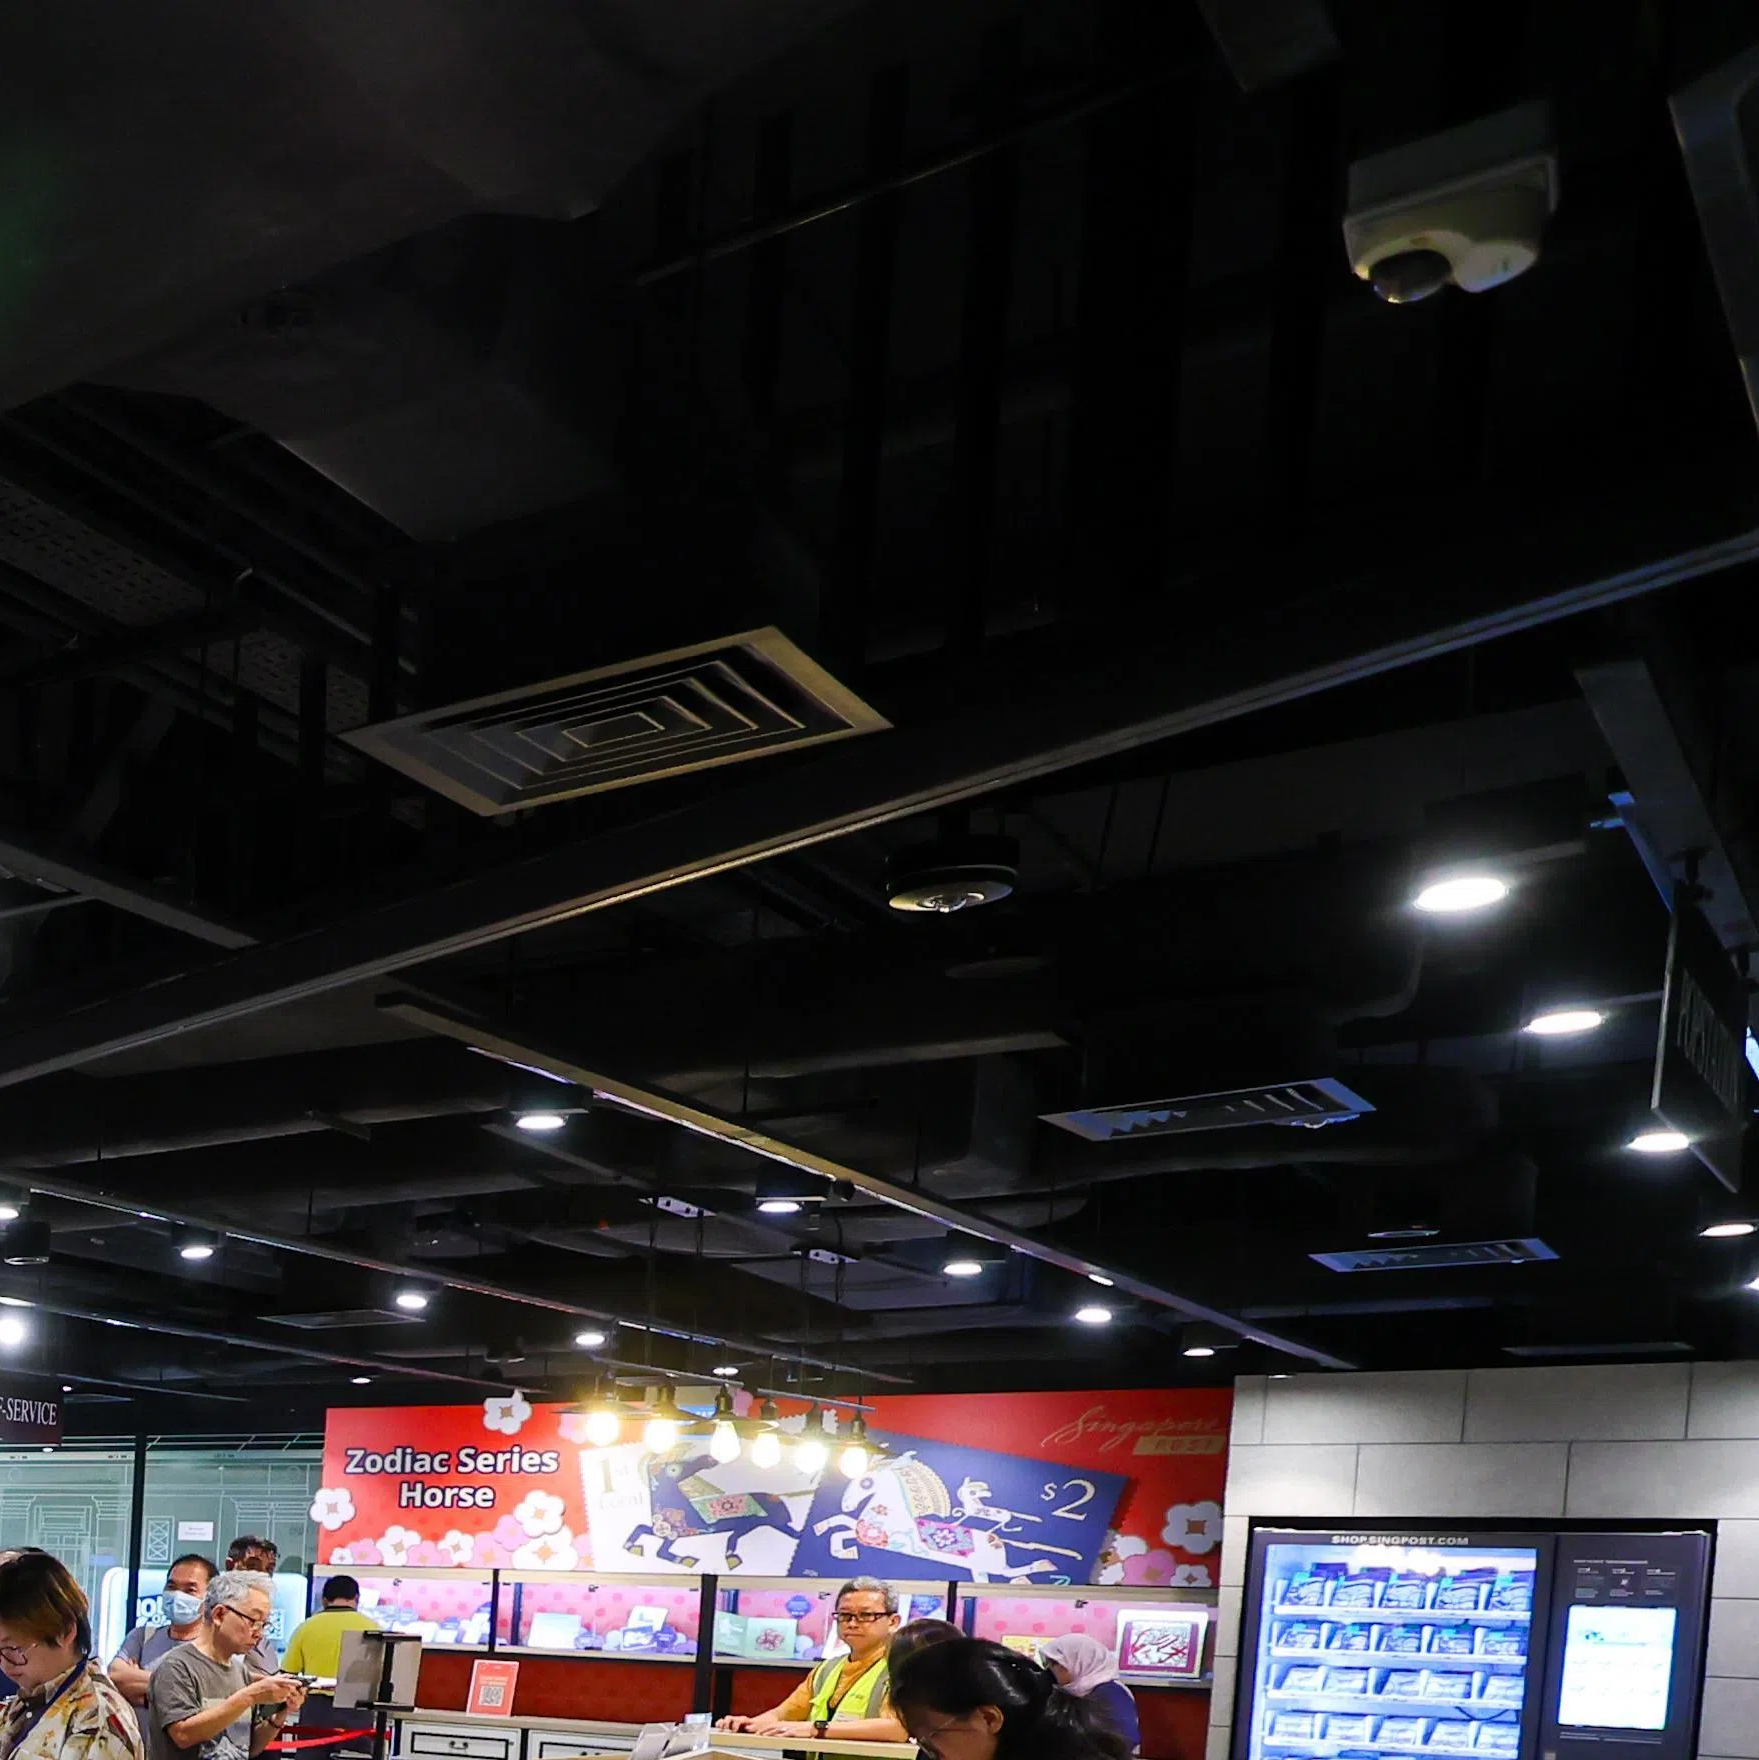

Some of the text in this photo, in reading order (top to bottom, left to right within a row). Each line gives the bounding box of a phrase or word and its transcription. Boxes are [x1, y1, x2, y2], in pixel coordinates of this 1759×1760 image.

[1040, 1405, 1223, 1452] Singapore
[345, 1444, 560, 1475] Zodiac Series
[398, 1481, 496, 1509] Horse
[1040, 1479, 1096, 1521] $2
